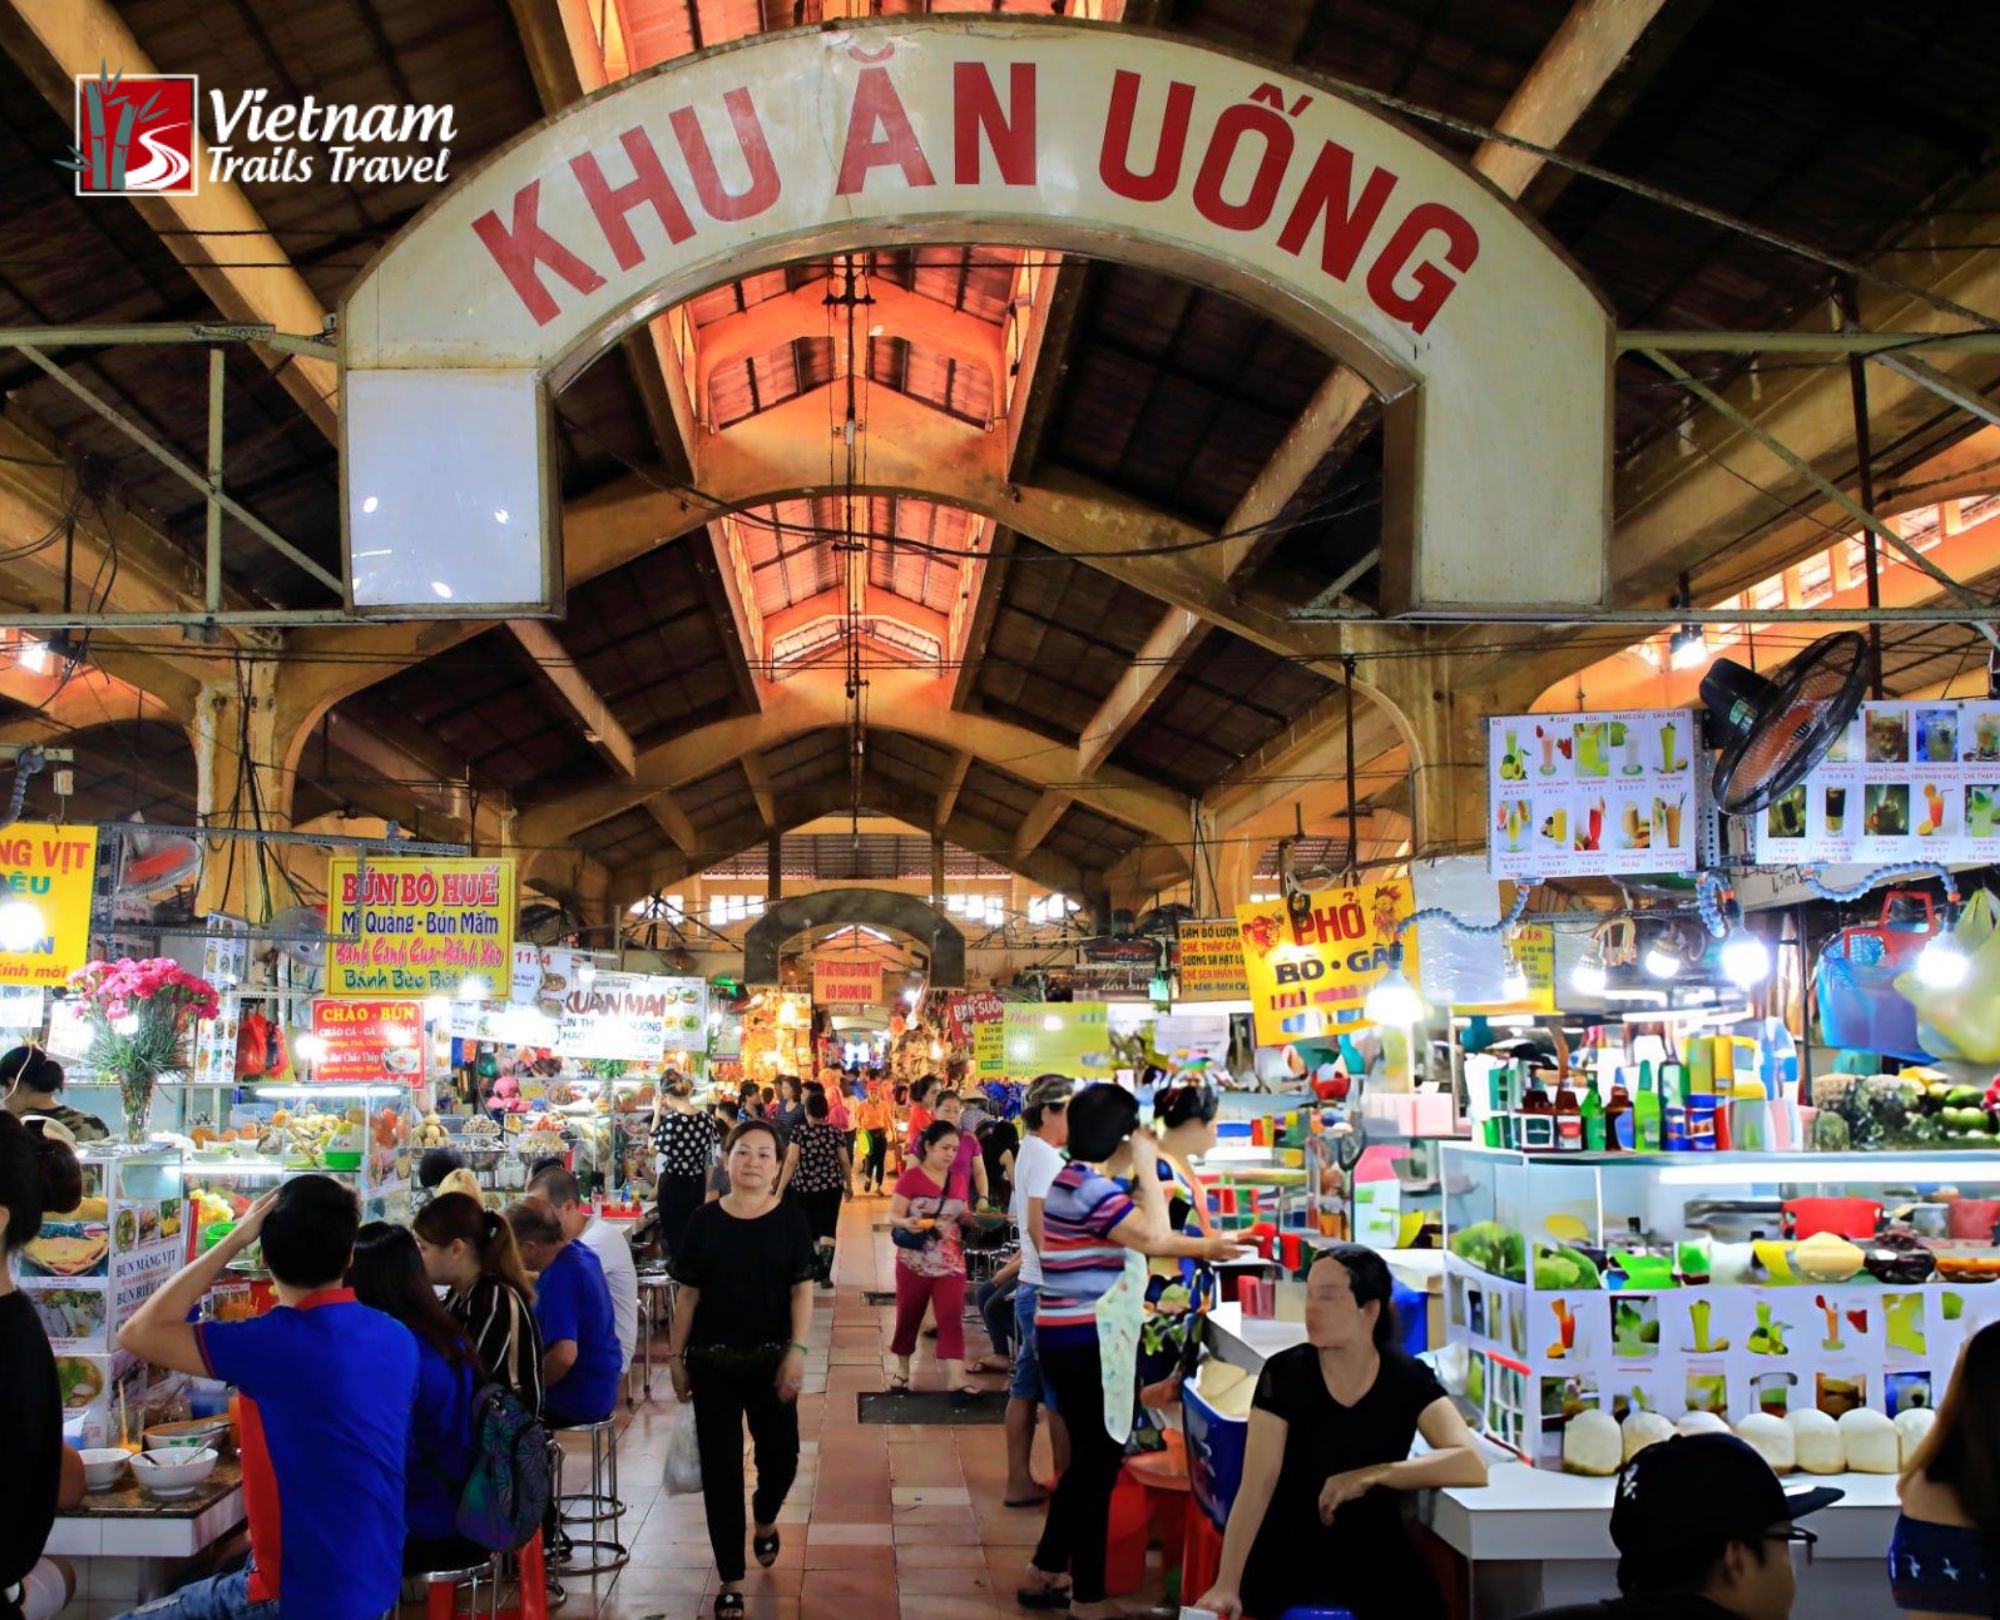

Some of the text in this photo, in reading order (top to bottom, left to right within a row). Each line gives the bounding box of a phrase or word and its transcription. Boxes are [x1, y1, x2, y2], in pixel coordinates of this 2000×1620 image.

[471, 42, 1480, 335] KHU ĂN UỐNG
[42, 840, 91, 875] VỊT
[400, 866, 438, 906] BÒ
[441, 863, 499, 906] HUẾ
[426, 911, 457, 934] Bún
[1291, 891, 1367, 947] PHỞ
